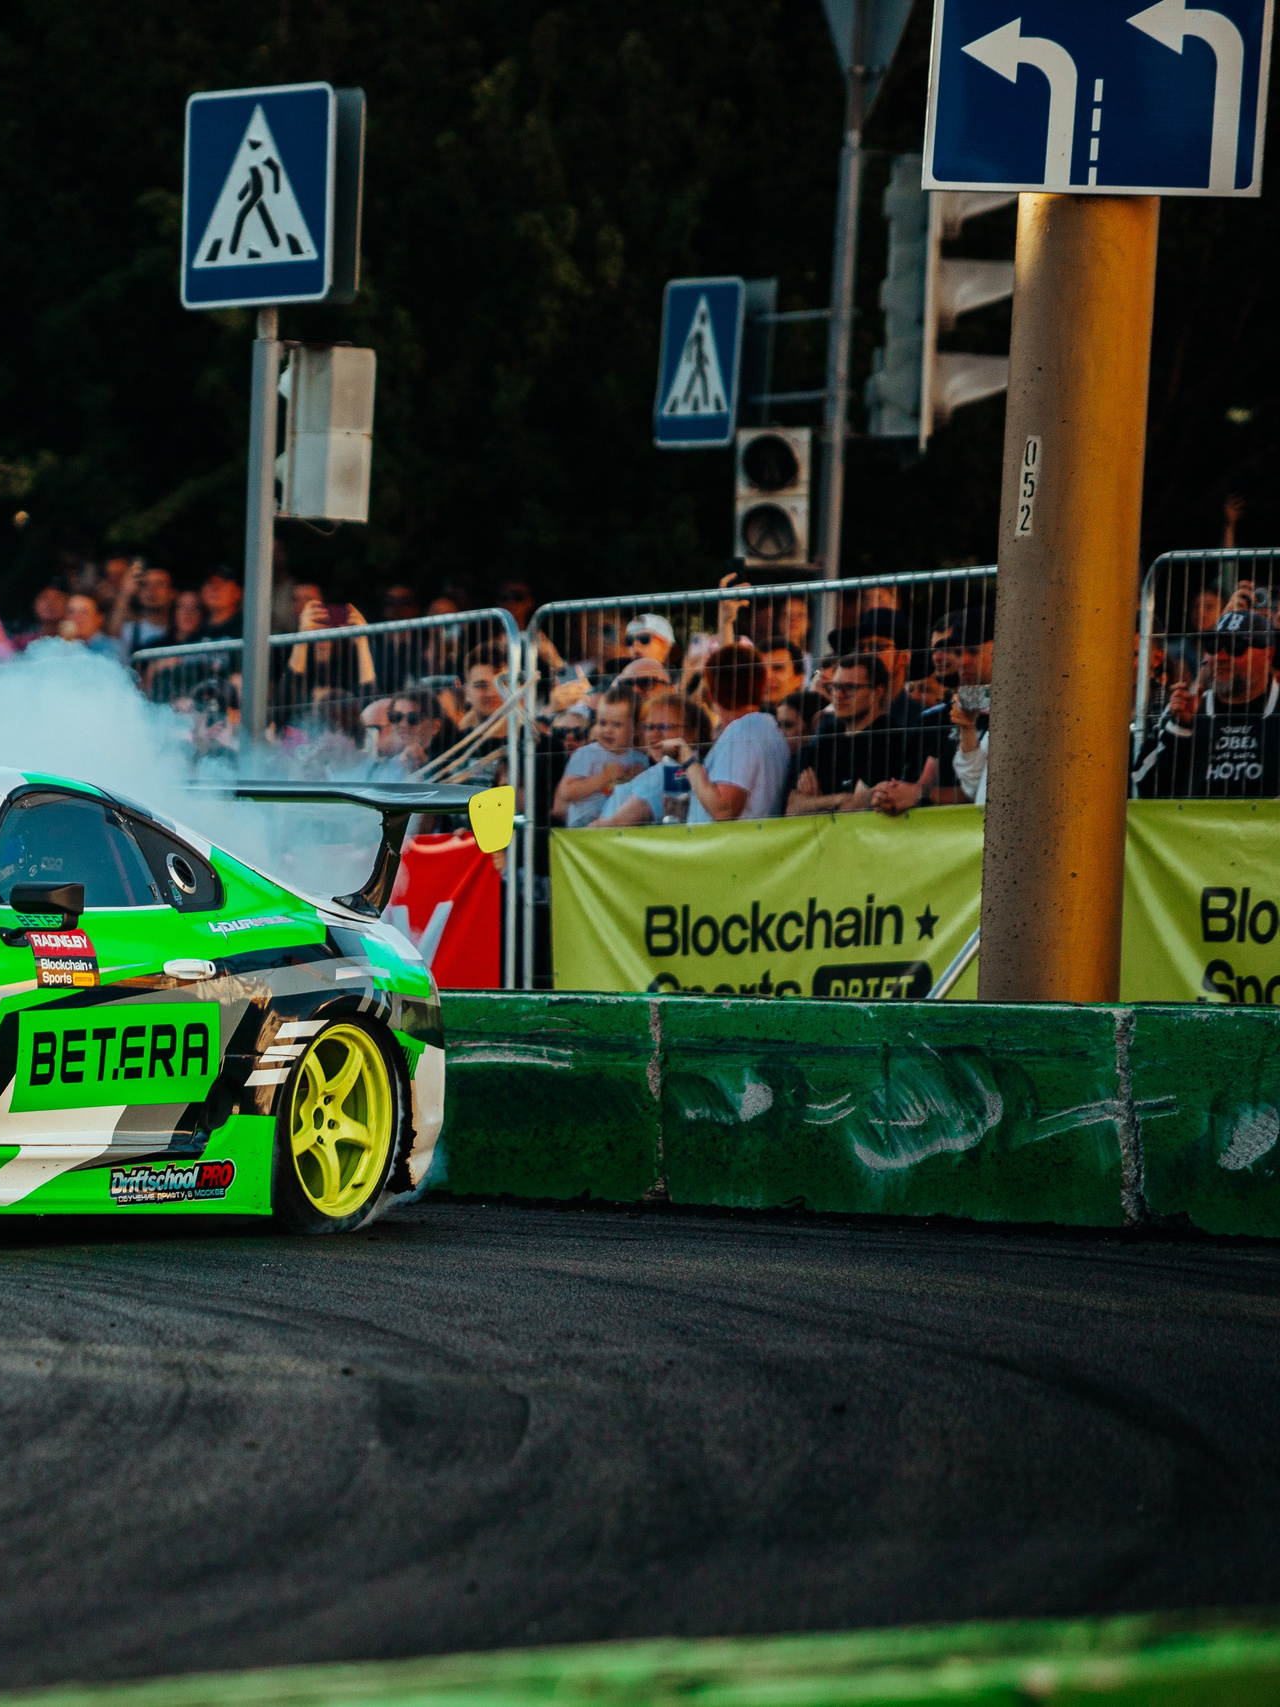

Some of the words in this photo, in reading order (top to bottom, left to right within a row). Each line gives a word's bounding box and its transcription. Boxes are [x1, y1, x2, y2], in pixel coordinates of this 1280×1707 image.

[645, 893, 904, 957] Blockchain
[40, 958, 88, 971] Blockchain
[42, 971, 72, 985] Sports
